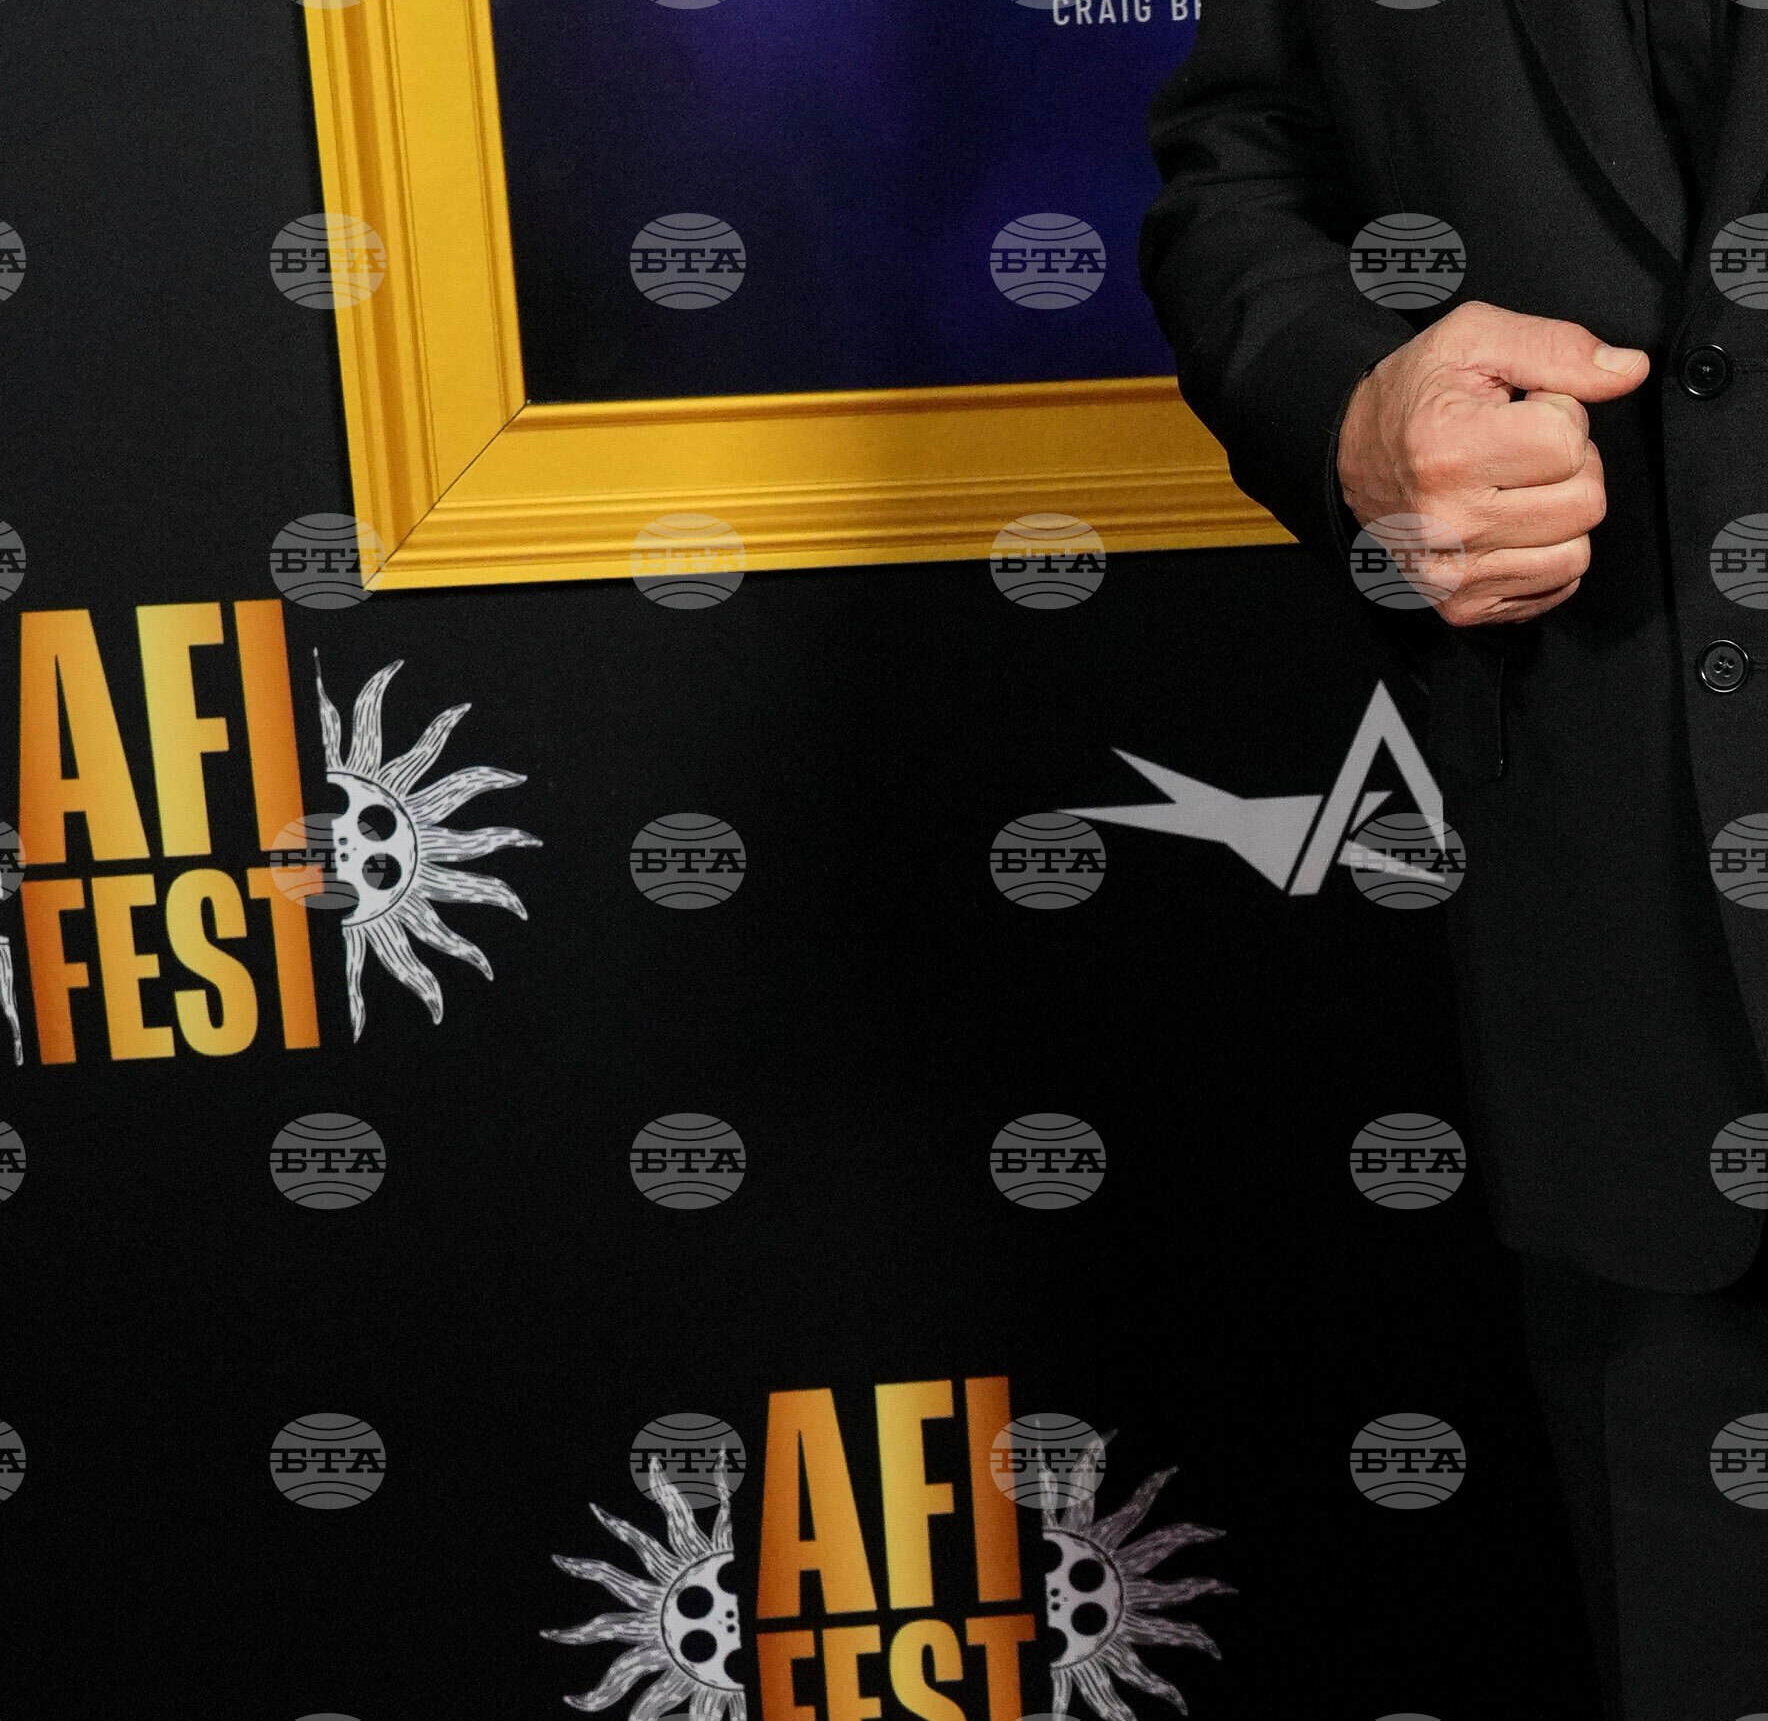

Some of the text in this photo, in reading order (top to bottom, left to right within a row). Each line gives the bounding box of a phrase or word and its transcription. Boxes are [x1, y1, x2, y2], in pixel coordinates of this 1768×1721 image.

[19, 599, 308, 866] AFI
[21, 864, 325, 1066] FEST
[756, 1375, 1023, 1620] AFI
